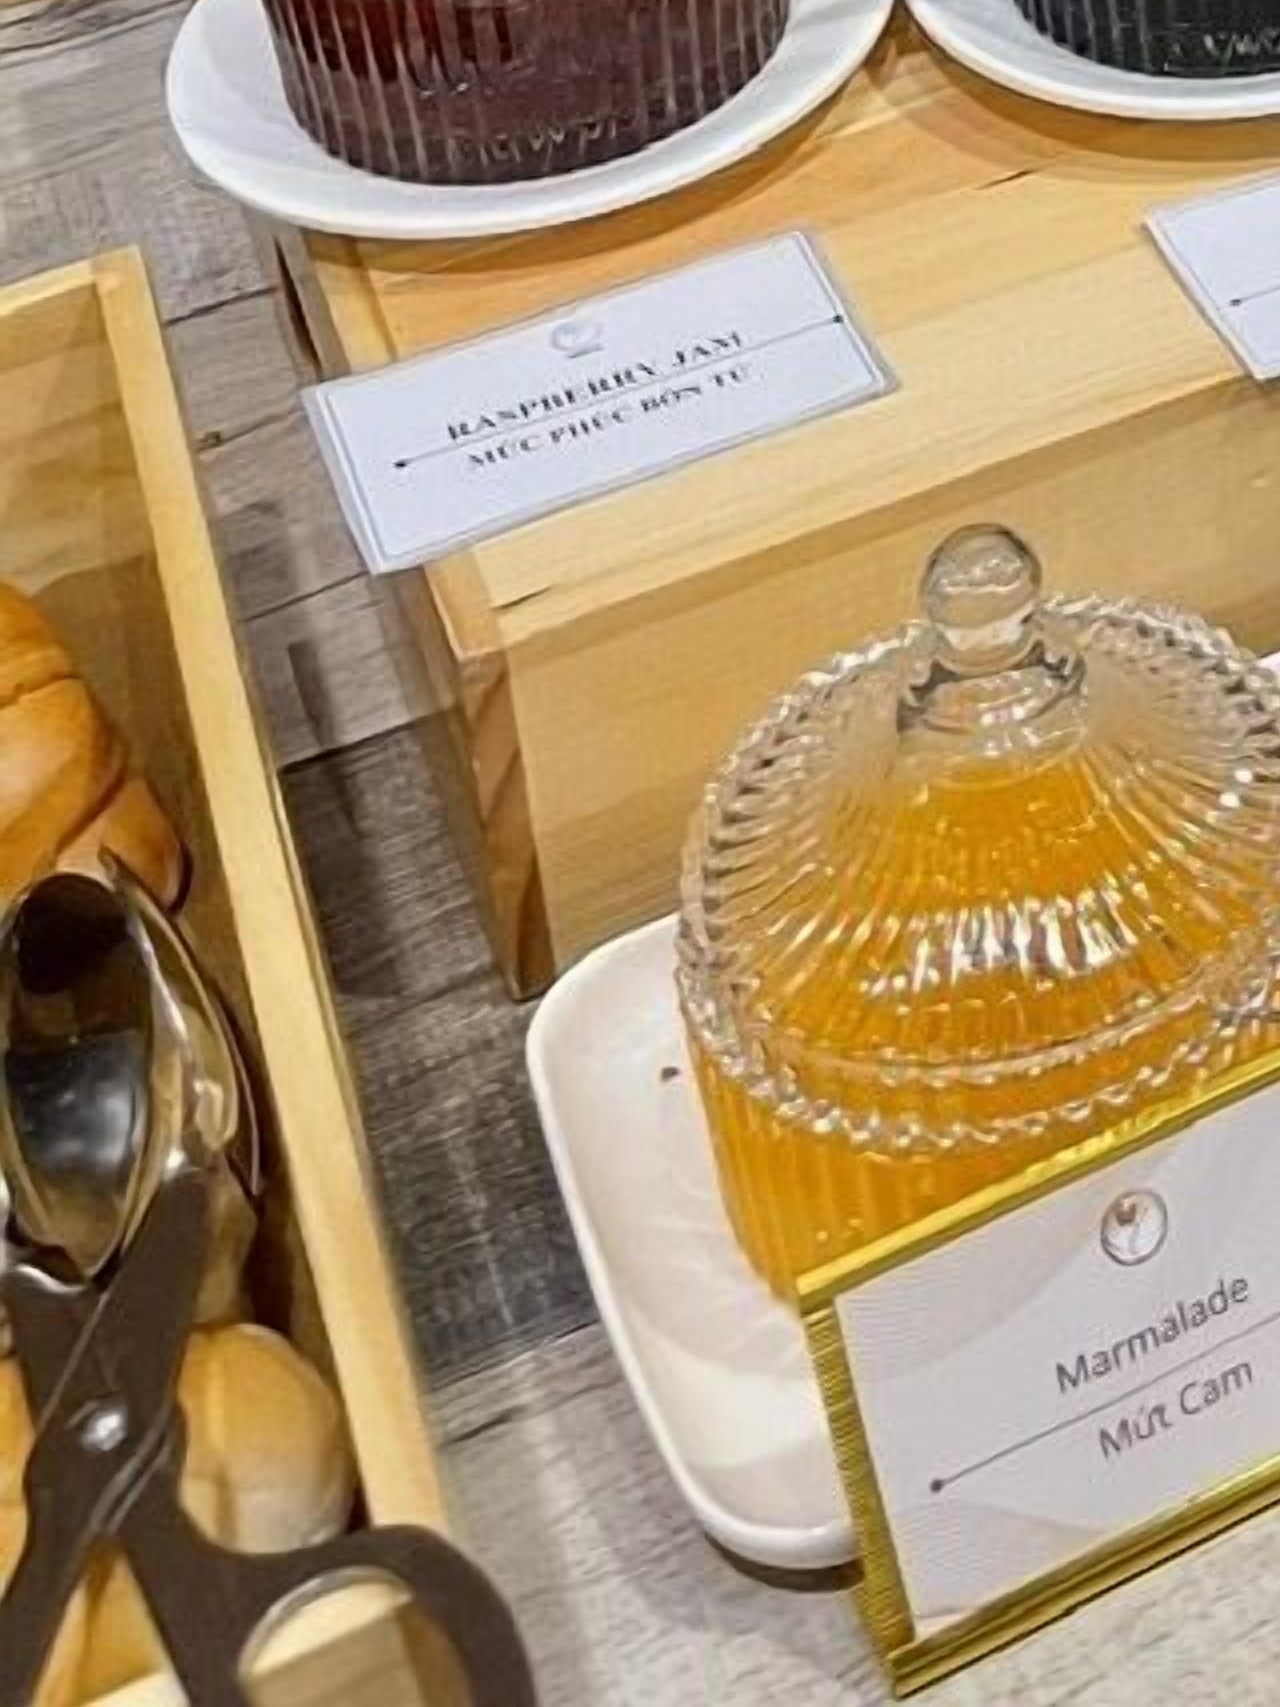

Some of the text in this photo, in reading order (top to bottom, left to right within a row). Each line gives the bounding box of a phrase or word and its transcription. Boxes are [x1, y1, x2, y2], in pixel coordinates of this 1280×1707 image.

[446, 330, 742, 441] RASPBERRY JAM
[1055, 1275, 1249, 1395] Marmalade
[1179, 1362, 1253, 1416] Cam
